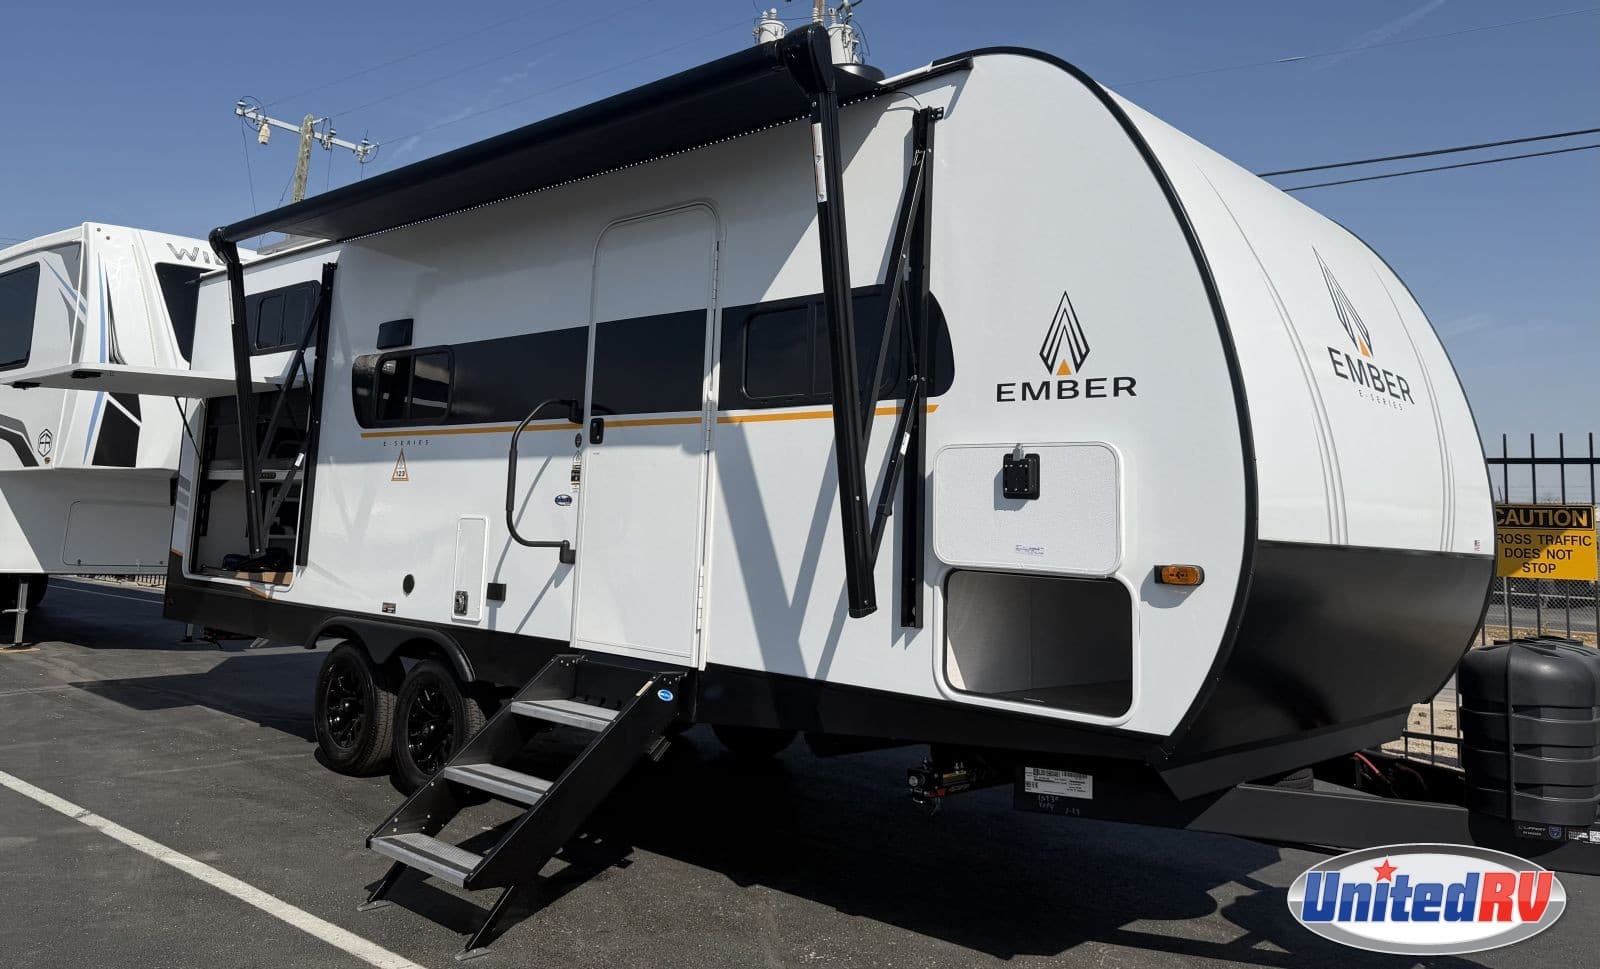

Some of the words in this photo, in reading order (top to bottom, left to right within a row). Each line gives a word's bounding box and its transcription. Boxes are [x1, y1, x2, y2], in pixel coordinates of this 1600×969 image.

[1327, 346, 1415, 405] EMBER
[996, 376, 1137, 402] EMBER
[1497, 533, 1532, 545] ROSS
[1537, 534, 1592, 547] TRAFFIC
[1504, 547, 1541, 560] DOES
[1546, 549, 1574, 561] NOT
[1522, 562, 1557, 574] STOP
